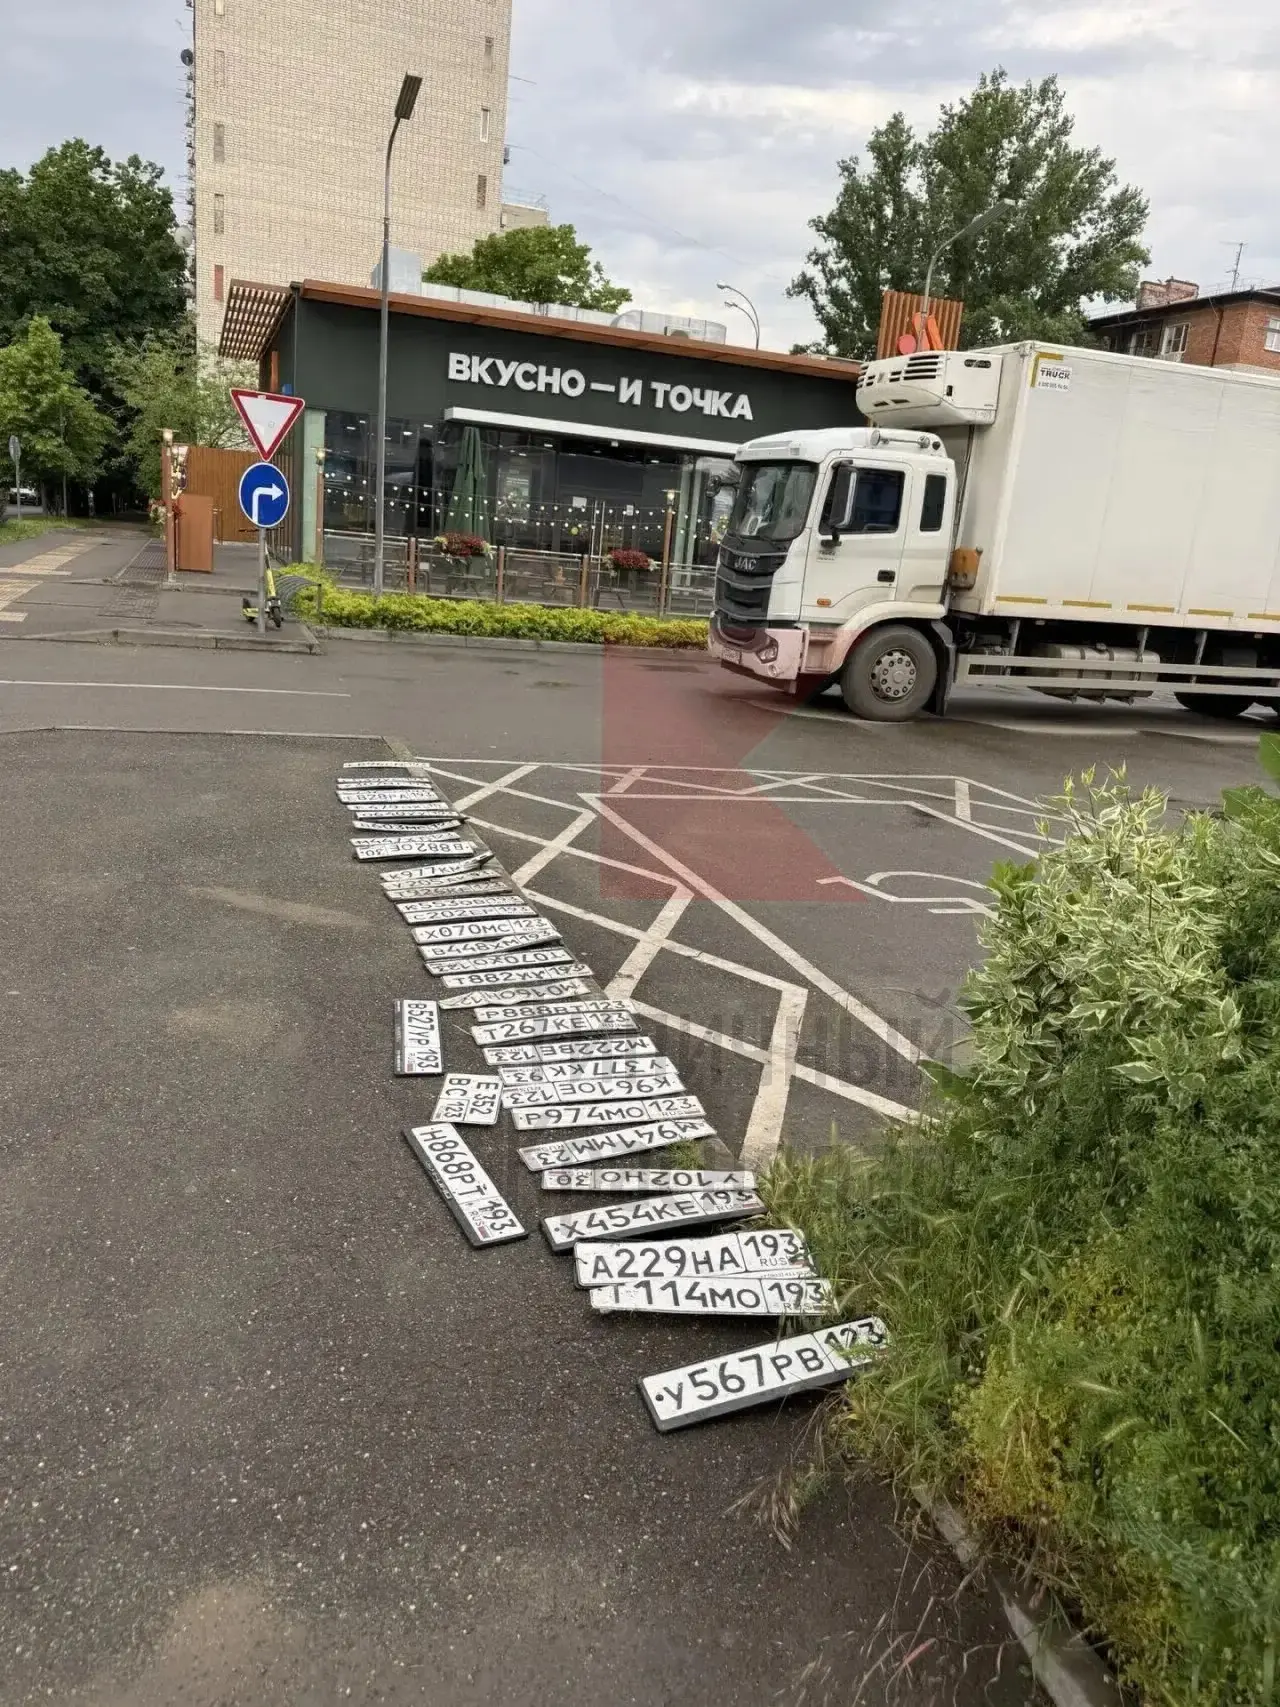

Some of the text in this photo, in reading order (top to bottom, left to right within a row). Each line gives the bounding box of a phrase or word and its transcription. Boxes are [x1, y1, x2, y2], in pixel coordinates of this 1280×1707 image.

[449, 353, 585, 397] ВКУСНО
[650, 381, 753, 420] ТОЧКА
[1040, 369, 1070, 379] TRUCK
[734, 557, 756, 571] JAC
[425, 918, 547, 940] Х070МС 123
[589, 1000, 624, 1011] 123
[408, 1003, 439, 1068] В527УР 193
[484, 1011, 624, 1040] Т267КЕ 123
[494, 1038, 648, 1062] М222ВЕ 123
[513, 1057, 663, 1083] У377КК 93
[508, 1076, 671, 1104] К961ОЕ 123
[444, 1101, 466, 1121] 123
[525, 1098, 692, 1126] Р974МО 123
[537, 1121, 699, 1167] М941ММ 23
[419, 1129, 486, 1196] Н868РТ
[478, 1200, 517, 1231] 193
[556, 1174, 591, 1187] 30
[601, 1171, 740, 1187] У102НО
[560, 1200, 699, 1238] Х454КЕ
[591, 1232, 799, 1279] А229НА 193
[759, 1256, 788, 1267] RUS
[611, 1279, 825, 1309] Т114МО 193
[663, 1347, 824, 1410] У567РВ
